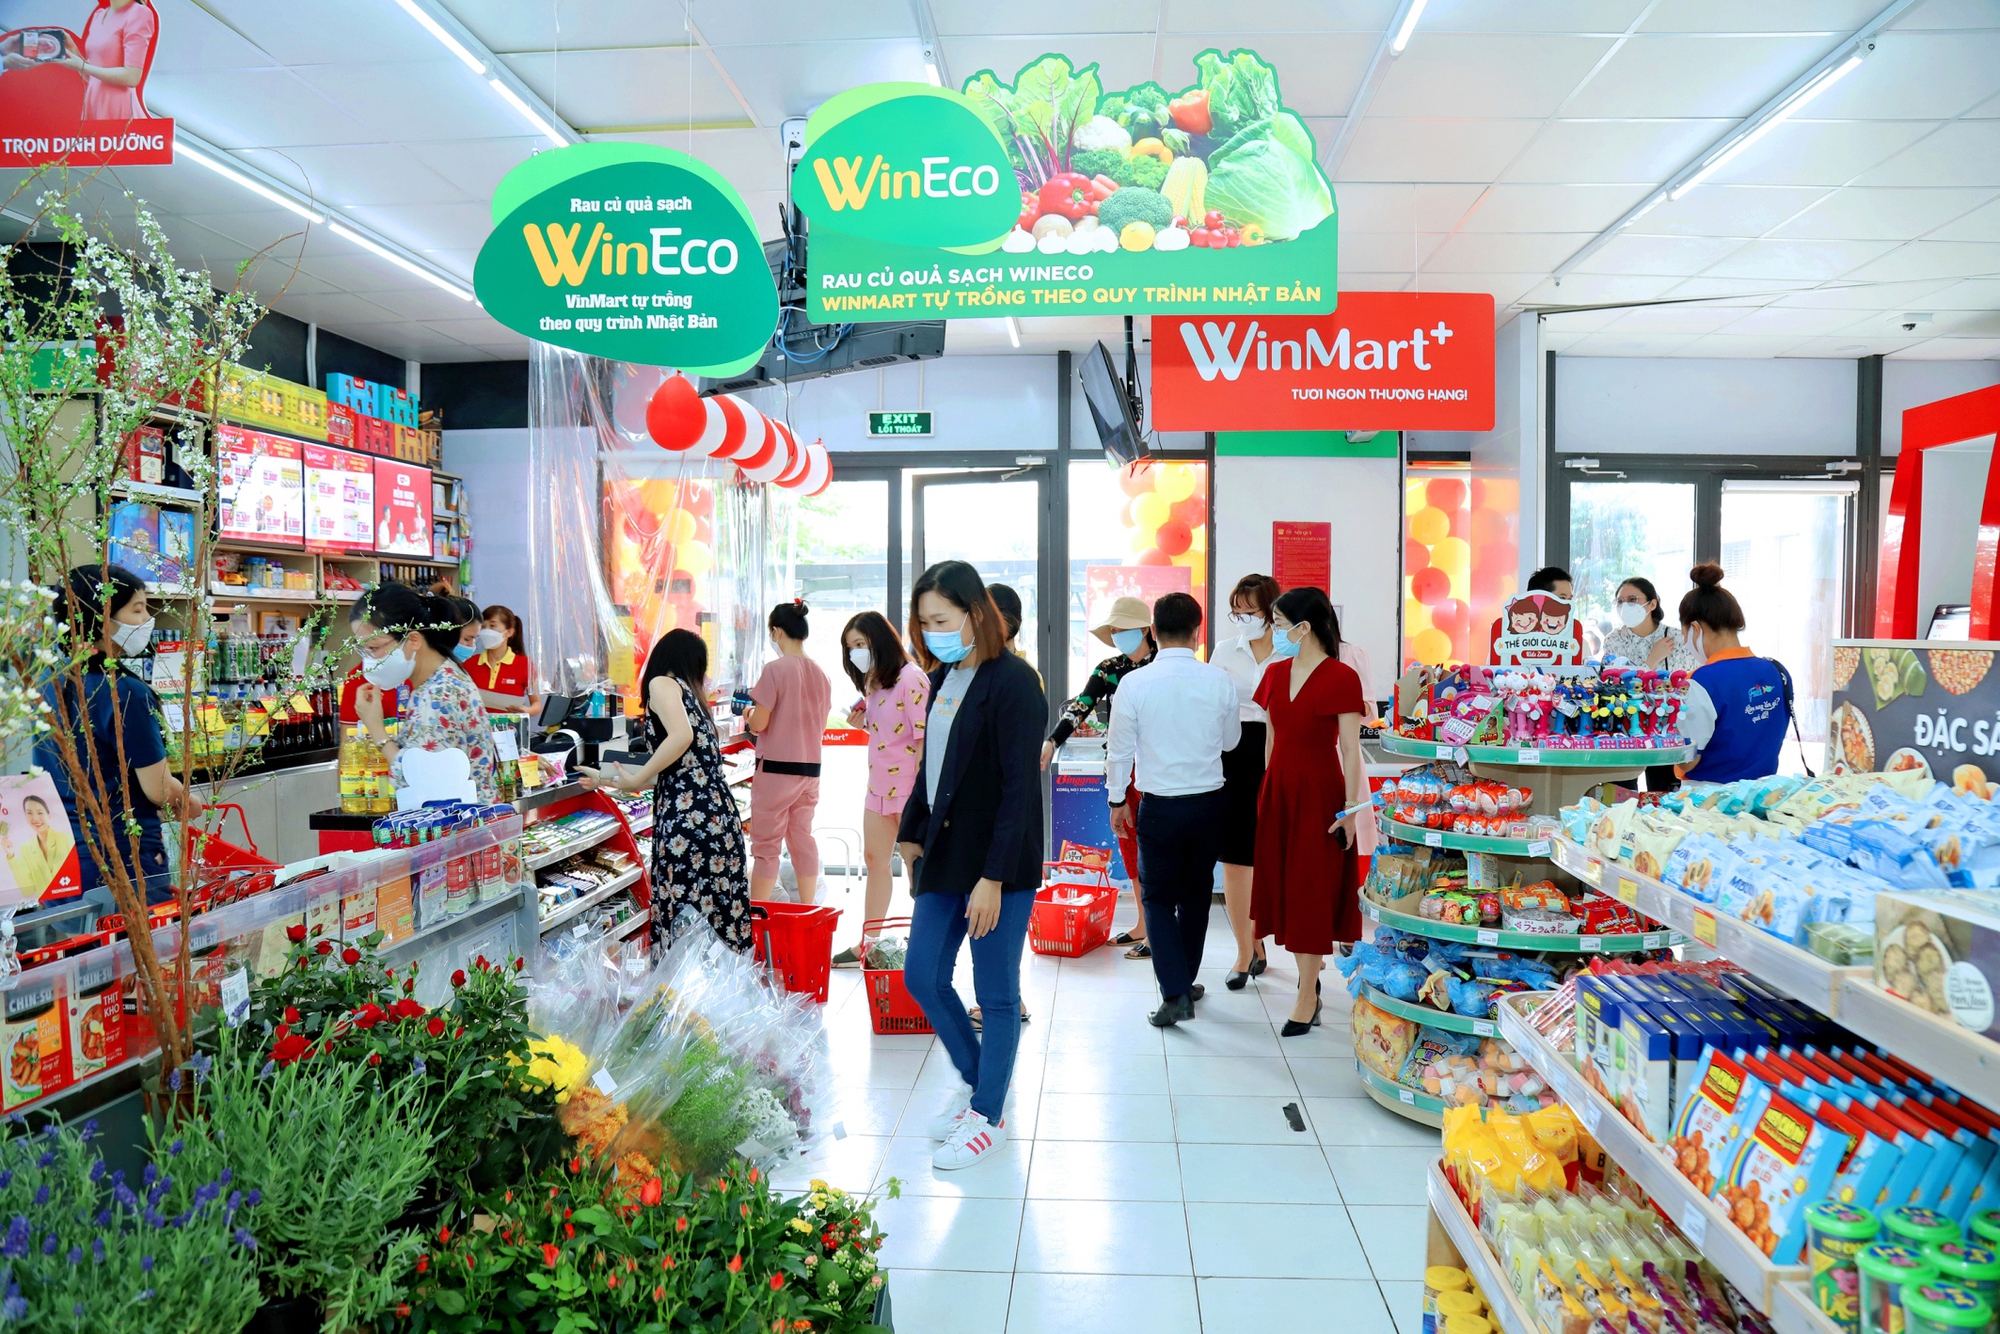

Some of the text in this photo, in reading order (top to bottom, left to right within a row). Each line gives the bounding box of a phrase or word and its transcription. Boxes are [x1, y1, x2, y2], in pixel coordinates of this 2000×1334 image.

[2, 132, 164, 158] TRỌN DINH DƯỠNG
[813, 154, 999, 212] WinEco
[570, 196, 692, 214] Rau củ quả sạch
[523, 222, 739, 287] WinEco
[822, 263, 1094, 289] RAU CỦ QUẢ SẠCH WINECO
[565, 290, 692, 310] VinMart tự trồng
[822, 280, 1321, 311] WINMART TỰ TRỒNG THEO QUY TRÌNH NHẬT BẢN
[539, 312, 718, 333] theo quy trình Nhật Bản
[1291, 388, 1468, 402] TƯƠI NGON THƯỢNG HẠNG!
[878, 423, 922, 433] LỐI THOÁT
[882, 413, 918, 424] EXIT
[1505, 637, 1569, 650] THẾ GIỚI CỦA BÉ
[822, 733, 849, 741] nMart+
[1914, 707, 1968, 756] ĐẶC
[8, 989, 54, 1013] CHIN-SU
[103, 1003, 120, 1018] KHO
